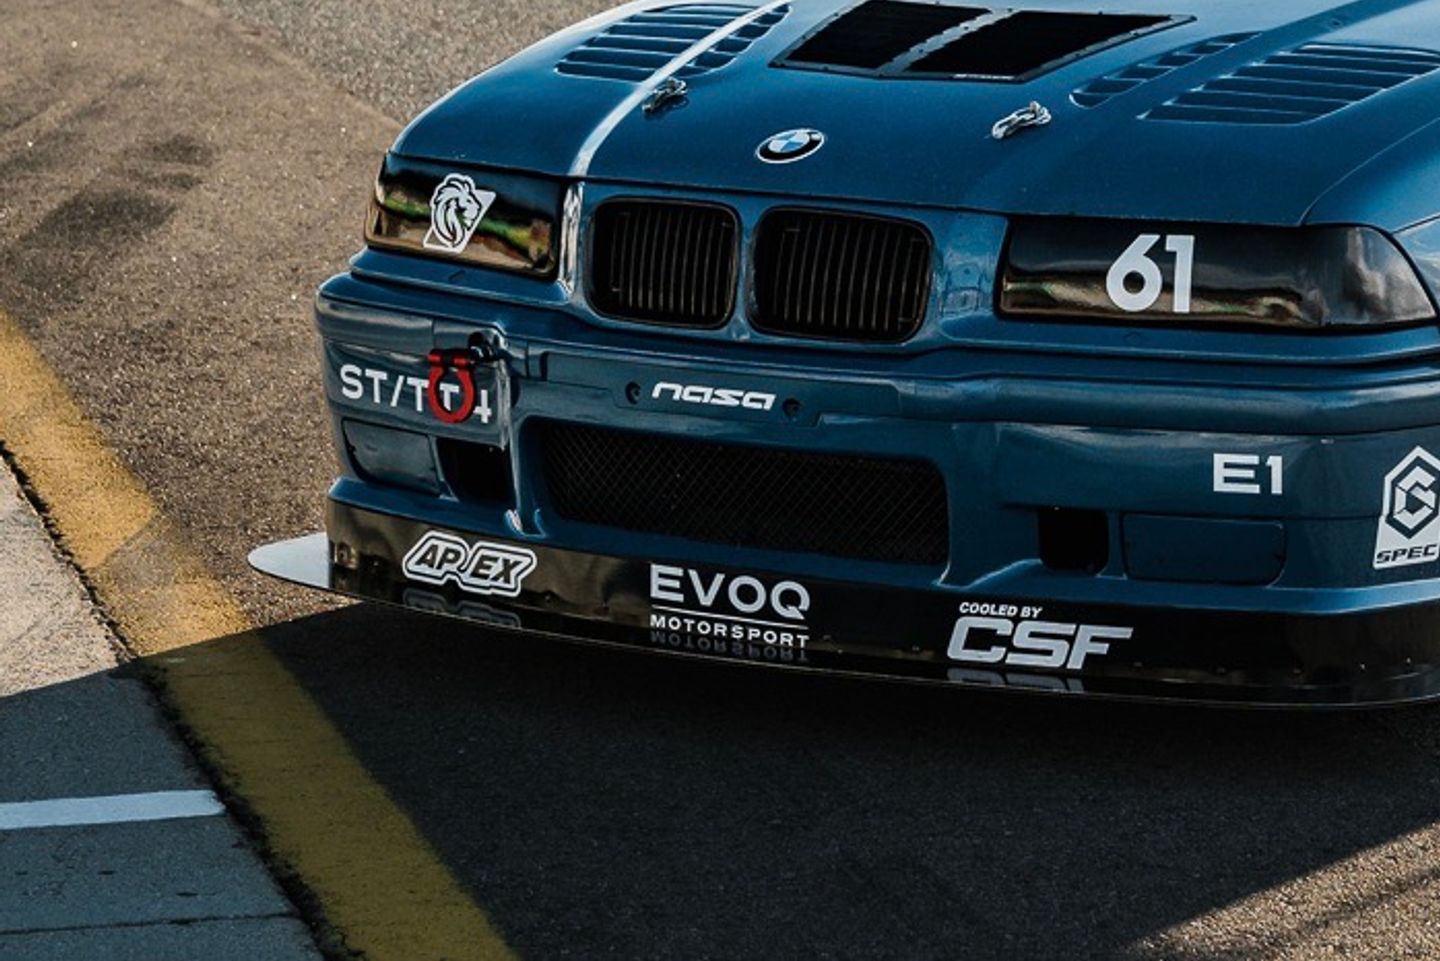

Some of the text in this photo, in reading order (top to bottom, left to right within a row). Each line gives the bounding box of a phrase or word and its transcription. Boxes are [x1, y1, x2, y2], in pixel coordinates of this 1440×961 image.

[1105, 234, 1195, 313] 61
[340, 364, 492, 424] ST/TT4
[652, 381, 776, 411] nasa
[1213, 453, 1284, 495] E1
[407, 537, 530, 591] APEX
[1376, 544, 1437, 564] SPEC
[651, 564, 811, 620] EVOQ
[959, 602, 1042, 618] COOLED BY
[651, 614, 810, 649] MOTORSPORT
[947, 616, 1133, 670] CSF
